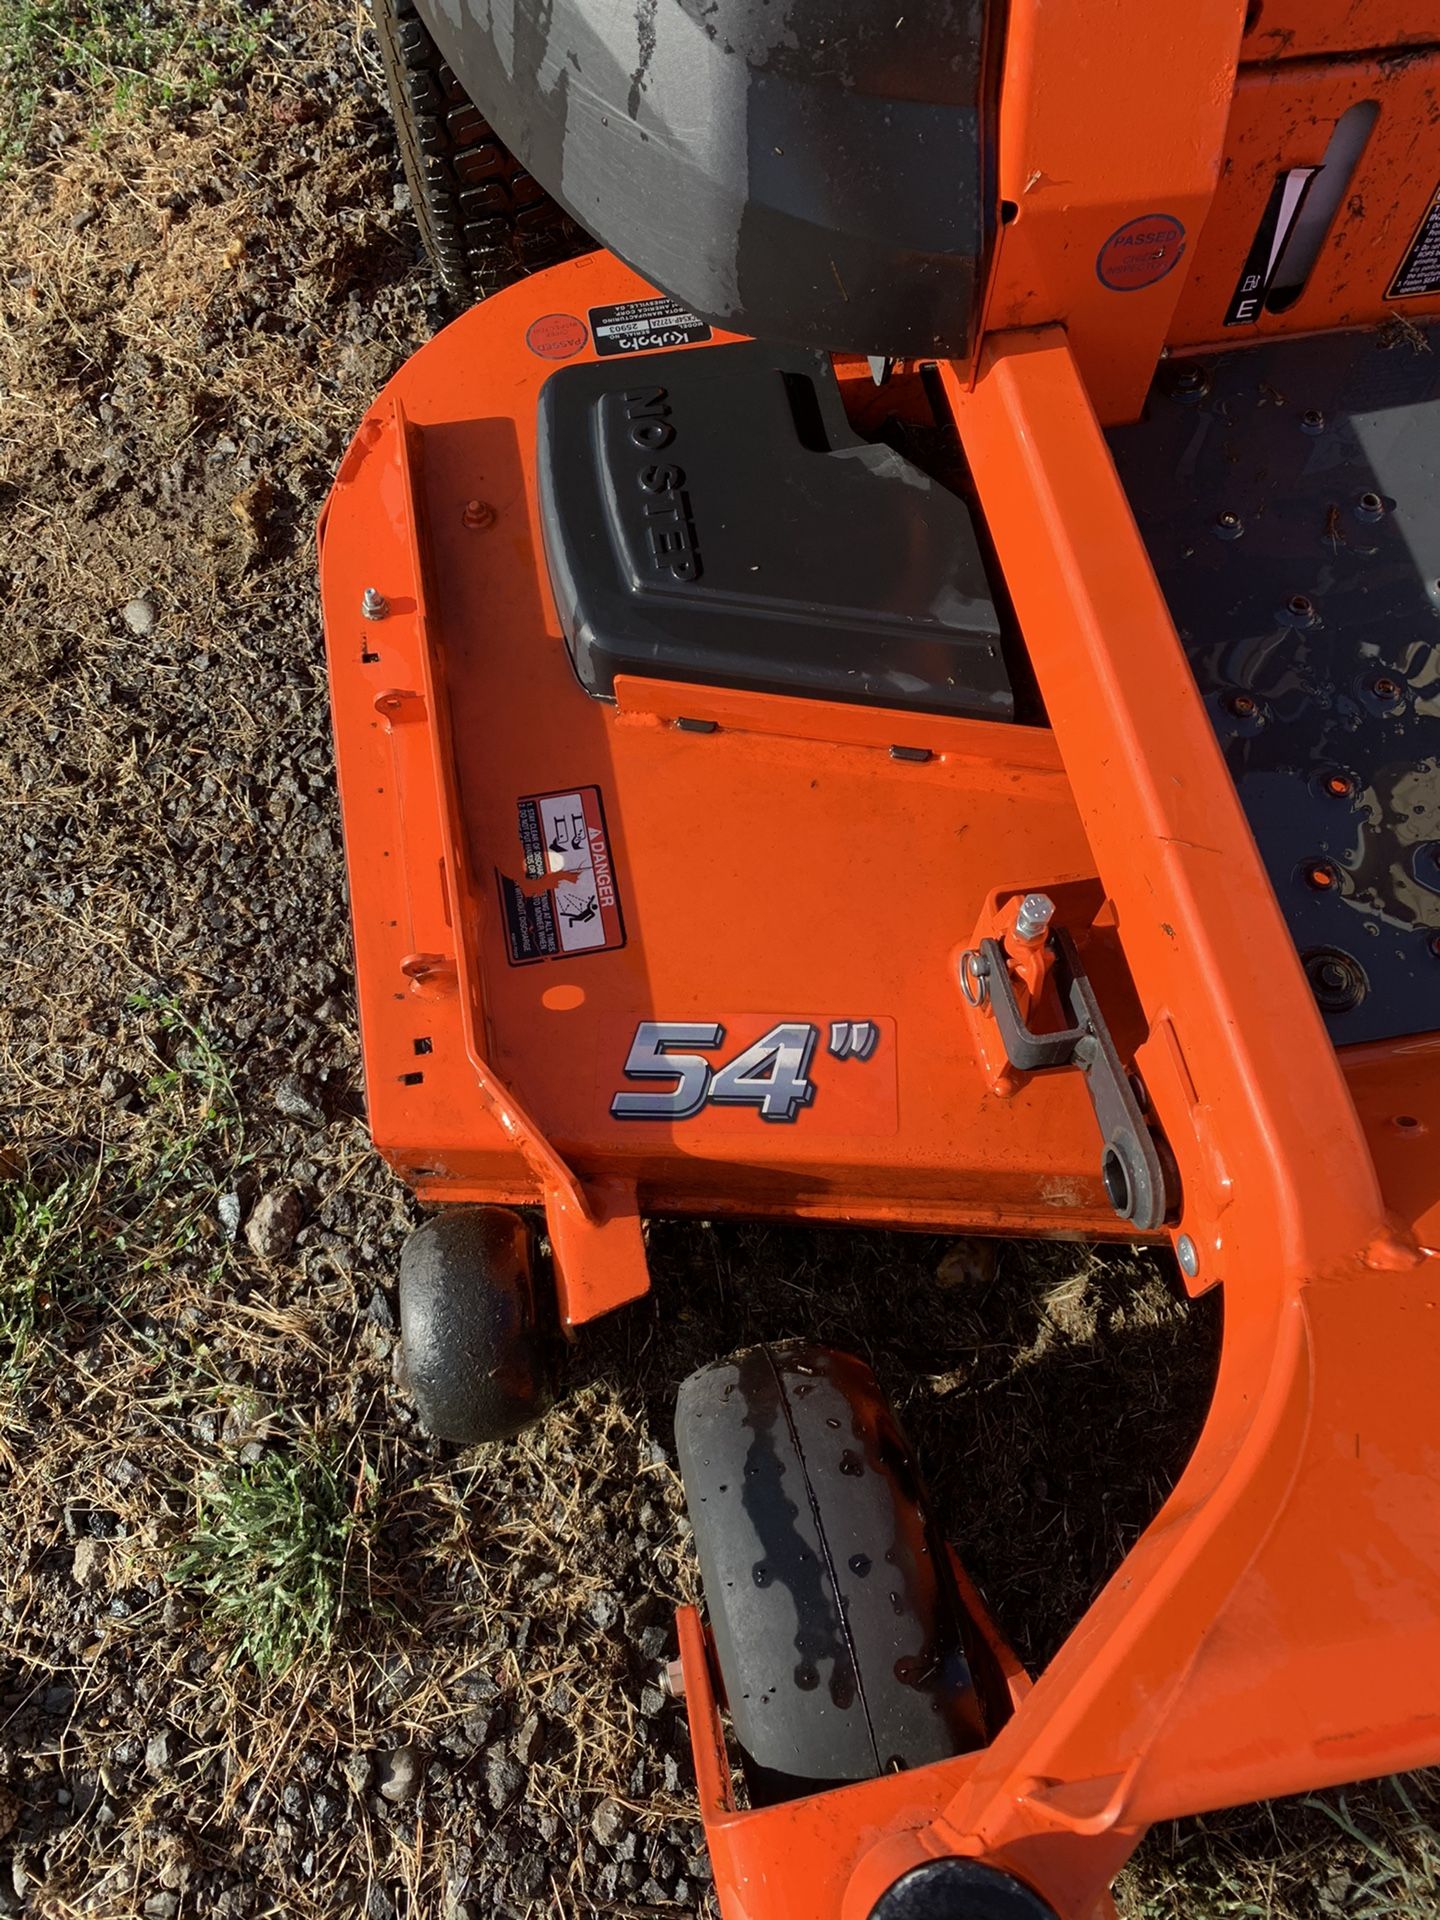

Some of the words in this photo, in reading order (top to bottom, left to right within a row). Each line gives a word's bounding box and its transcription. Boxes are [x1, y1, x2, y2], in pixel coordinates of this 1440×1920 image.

[1114, 230, 1177, 248] PASSED
[602, 311, 663, 324] MANUFACTURING
[614, 308, 638, 316] CORP.
[1236, 299, 1257, 319] E
[609, 323, 638, 333] 25903
[625, 329, 650, 337] SERIAL
[619, 331, 689, 350] Kubota
[624, 386, 676, 449] NO
[638, 464, 703, 580] STEP
[519, 809, 526, 818] DO
[526, 808, 535, 822] STAY
[520, 819, 529, 831] NOT
[529, 822, 538, 841] CLEAR
[523, 831, 531, 843] PUT
[532, 842, 539, 850] OF
[524, 843, 534, 863] HANDS
[527, 864, 536, 873] OR
[591, 842, 615, 908] DANGER
[514, 887, 525, 915] WITHOUT
[534, 906, 544, 930] MOWER
[543, 911, 550, 920] AT
[519, 915, 531, 952] DISCHARGE
[544, 920, 552, 932] ALL
[537, 930, 548, 949] WHEN
[610, 1021, 880, 1124] 54"
